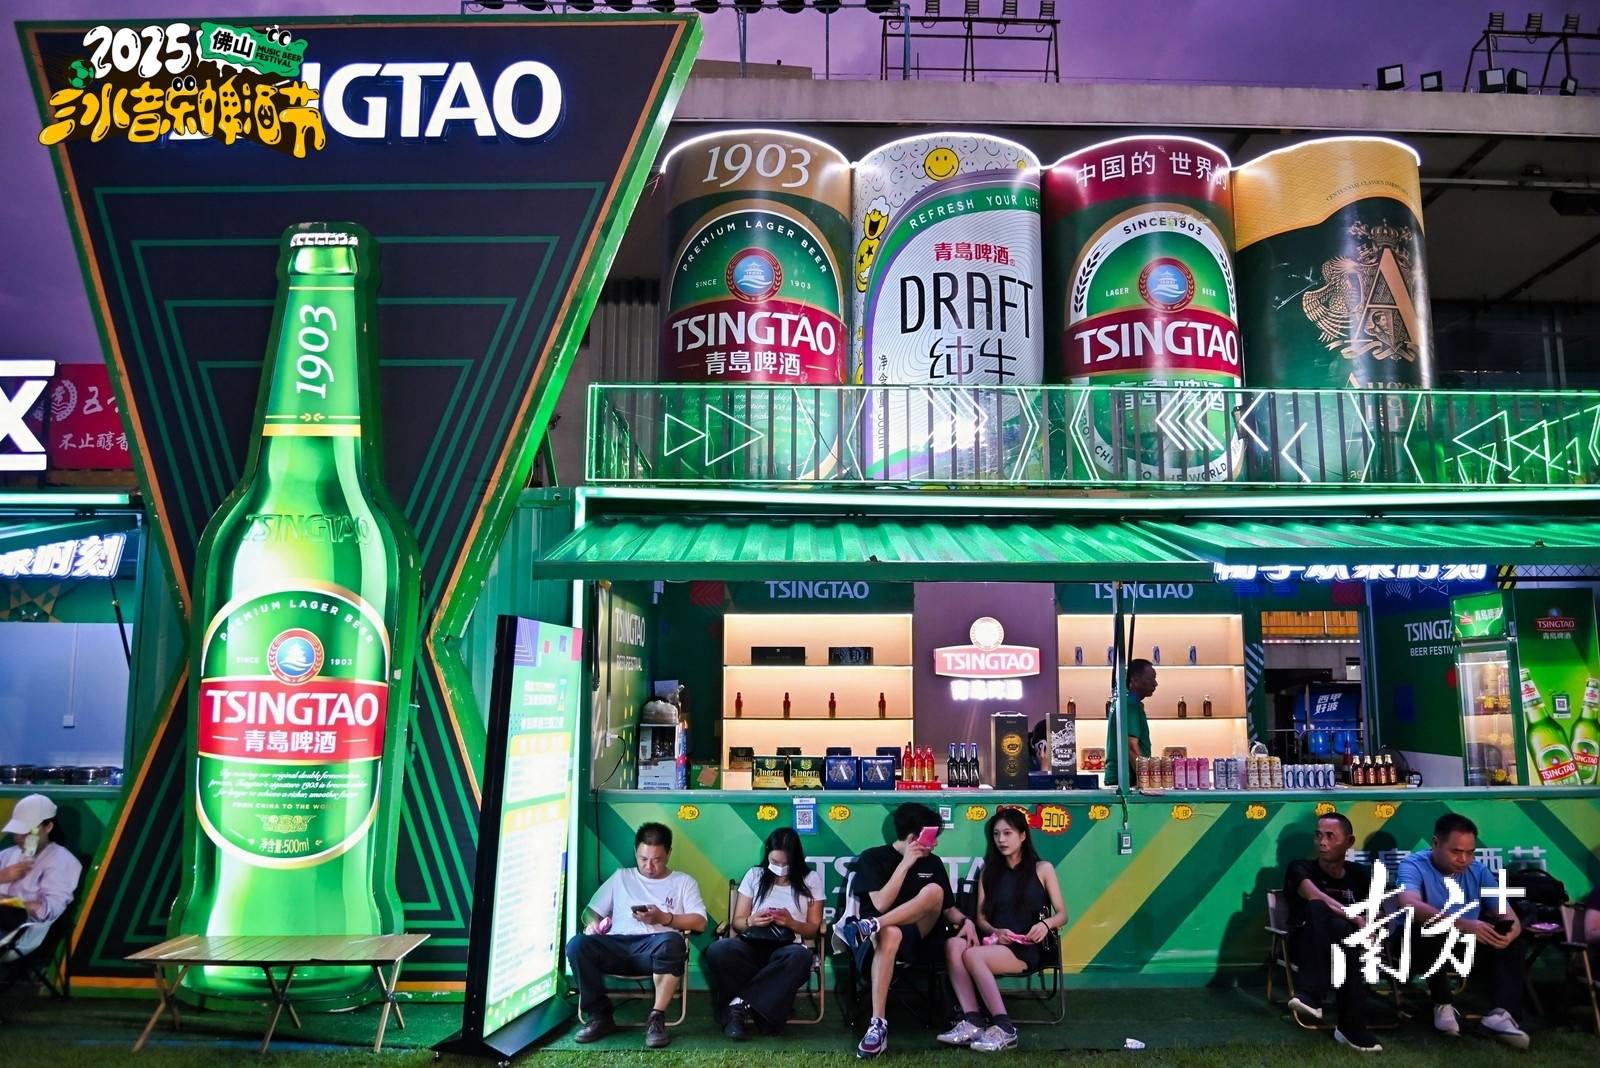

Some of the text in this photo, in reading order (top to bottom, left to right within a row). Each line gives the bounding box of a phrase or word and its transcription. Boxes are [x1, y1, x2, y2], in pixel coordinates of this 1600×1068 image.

[702, 142, 812, 188] 1903
[1075, 151, 1156, 188] 中国的
[909, 195, 1039, 229] REFRESH YOUR LIFE
[1122, 217, 1167, 236] SINCE
[682, 220, 828, 274] PREMIUM LAGER BEER
[695, 278, 812, 290] SINCE 1903
[1106, 287, 1130, 298] LAGER
[900, 271, 1034, 339] DRAFT
[671, 310, 836, 356] TSINGTAO
[1074, 320, 1239, 367] TSINGTAO
[296, 304, 337, 400] 1903
[243, 514, 373, 546] TSINGTAO
[764, 580, 870, 600] TSINGTAO
[220, 600, 374, 645] PREMIUM LAGER BEER
[614, 607, 646, 648] TSINGTAO
[1536, 620, 1575, 629] TSINGTAO
[330, 658, 353, 666] 1903
[942, 652, 1035, 671] TSINGTAO
[1410, 646, 1428, 657] BEER
[206, 688, 379, 726] TSINGTAO
[1541, 763, 1576, 780] TSINGTAO
[1044, 812, 1065, 828] 300
